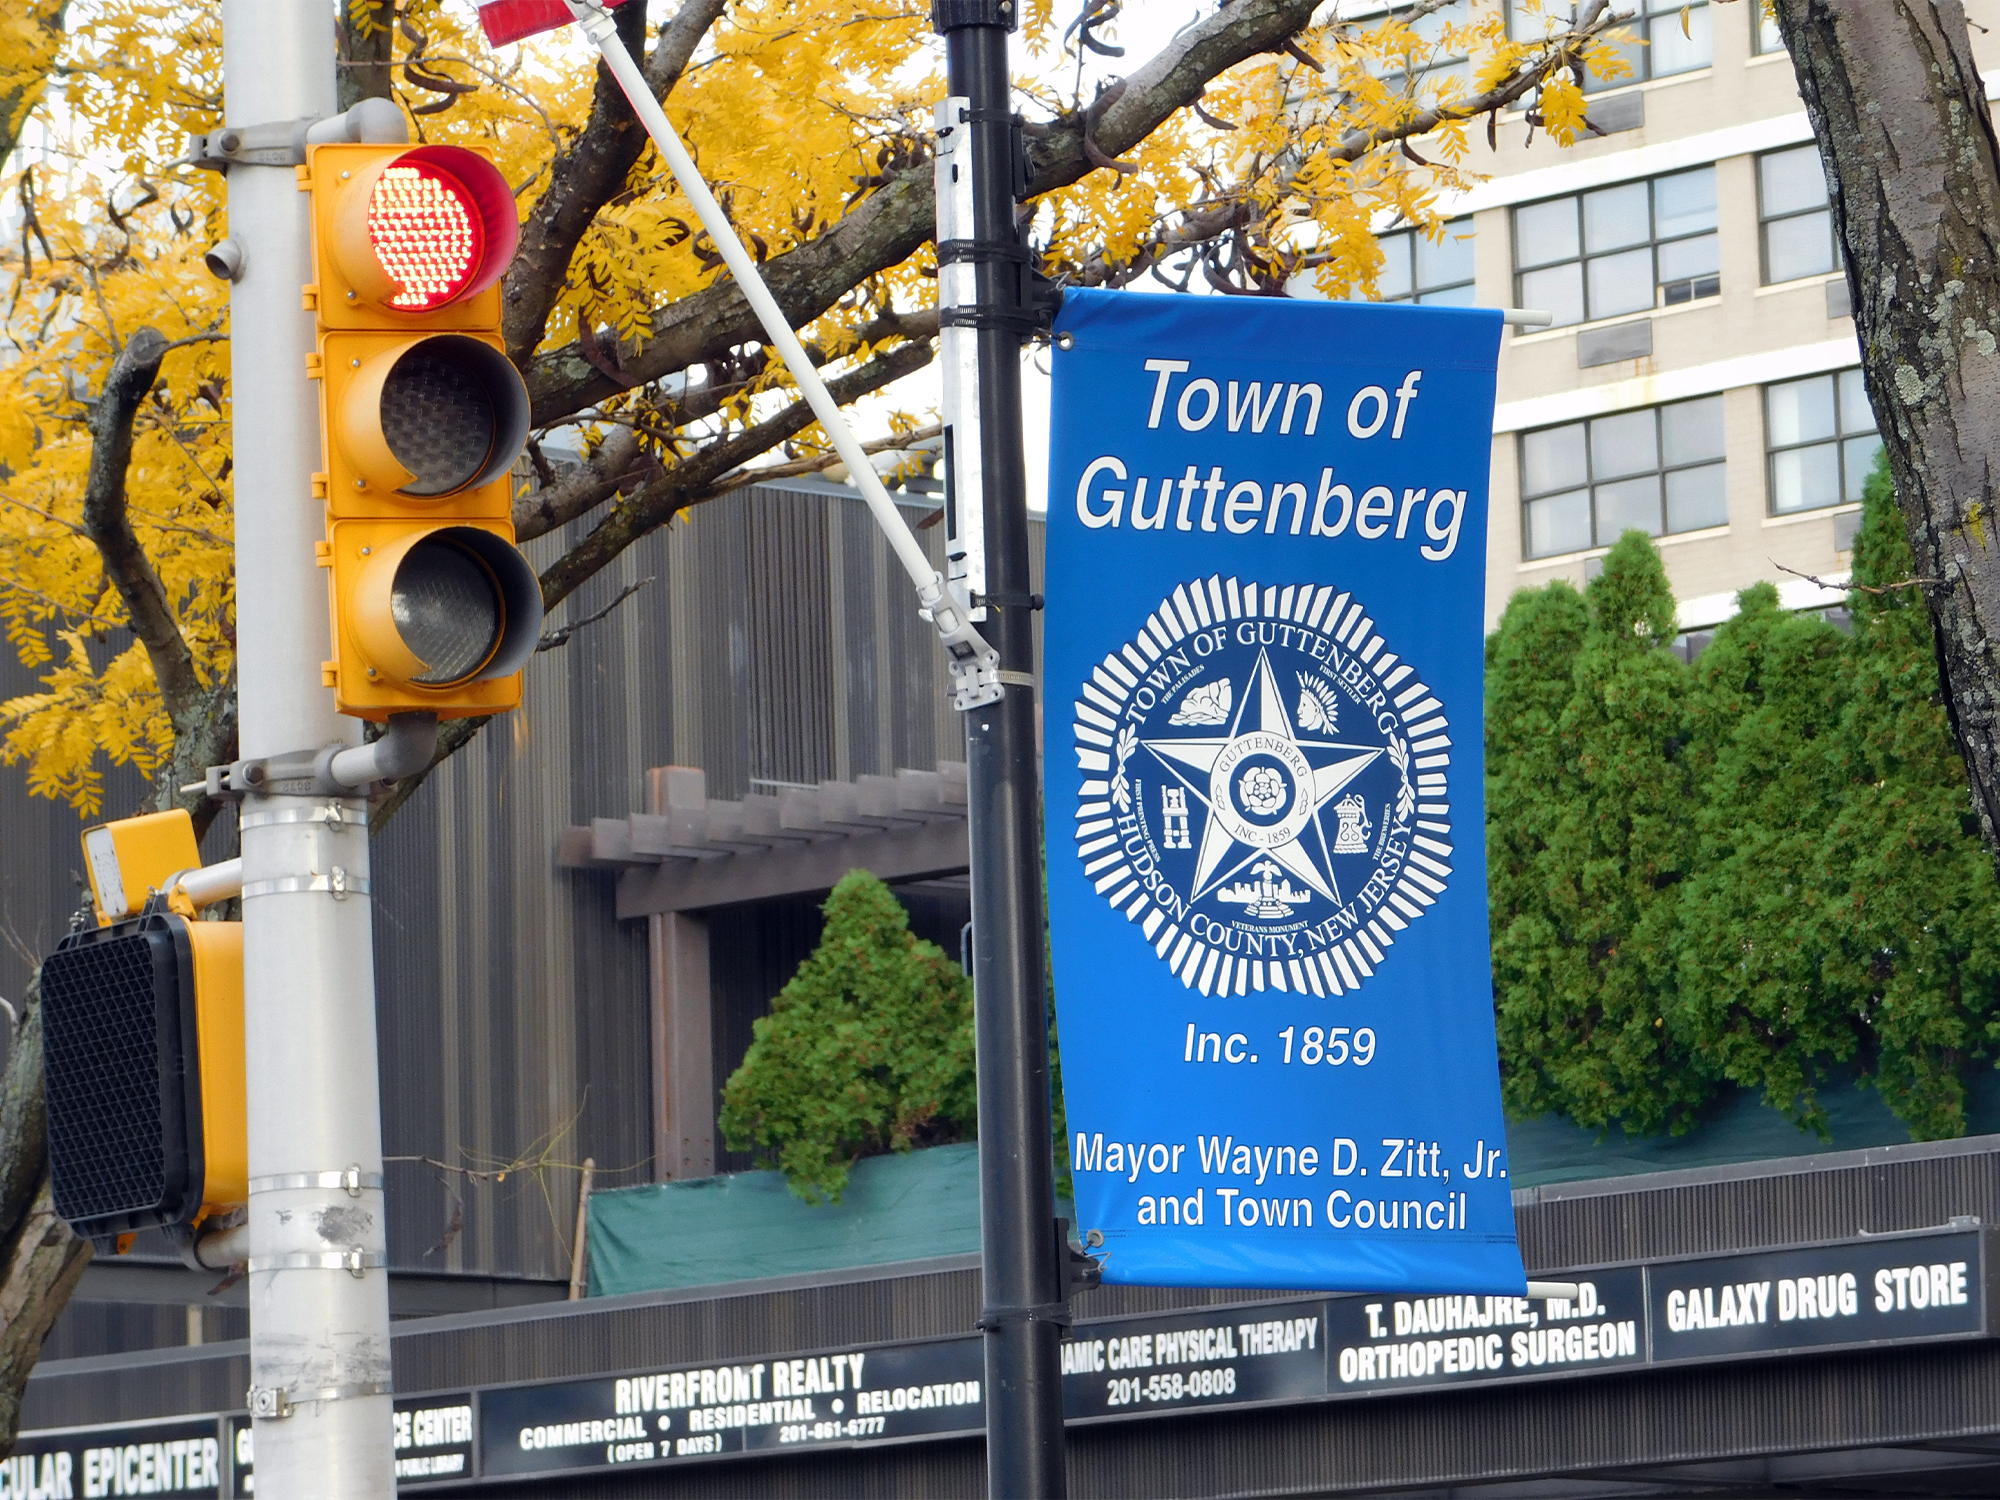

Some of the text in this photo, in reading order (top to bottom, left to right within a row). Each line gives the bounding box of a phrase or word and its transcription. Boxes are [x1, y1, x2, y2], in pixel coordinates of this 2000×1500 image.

[1144, 358, 1422, 439] Town of
[1076, 456, 1467, 562] Guttenberg
[1125, 621, 1399, 736] TOWN OF GUTTENBERG
[1172, 663, 1205, 694] PALISADES
[1319, 663, 1362, 705] FIRST SETTLER
[1219, 736, 1308, 778] GUTTENBERG
[1136, 801, 1151, 840] PRINTING
[1146, 839, 1162, 863] PRESS
[1234, 823, 1291, 844] INC 1859
[1116, 811, 1412, 958] HUDSON COUNTY, NEW JERSEY
[1231, 919, 1309, 934] VETERANS MONUMENT
[1184, 1023, 1377, 1066] Inc. 1859
[1074, 1131, 1507, 1185] Mayor Wayne D. Zitt, Jr.
[1137, 1188, 1467, 1231] and Town Council
[1364, 1303, 1388, 1338] T.
[1667, 1261, 1968, 1333] GALAXY DRUG STORE
[1107, 1334, 1153, 1371] CARE
[1155, 1326, 1238, 1366] PHYSICAL
[1239, 1317, 1318, 1356] THERAPY
[1339, 1320, 1636, 1383] ORTHOPEDIC SURGEON
[615, 1353, 865, 1415] RIVERFRONT REALTY
[1107, 1367, 1236, 1406] 201-558-0808
[413, 1405, 473, 1447] CENTER
[519, 1381, 981, 1451] COMMERCIAL RESIDENTIAL RELOCATION
[82, 1436, 220, 1499] EPICENTER
[607, 1432, 723, 1464] (OPEN 7 DAYS)
